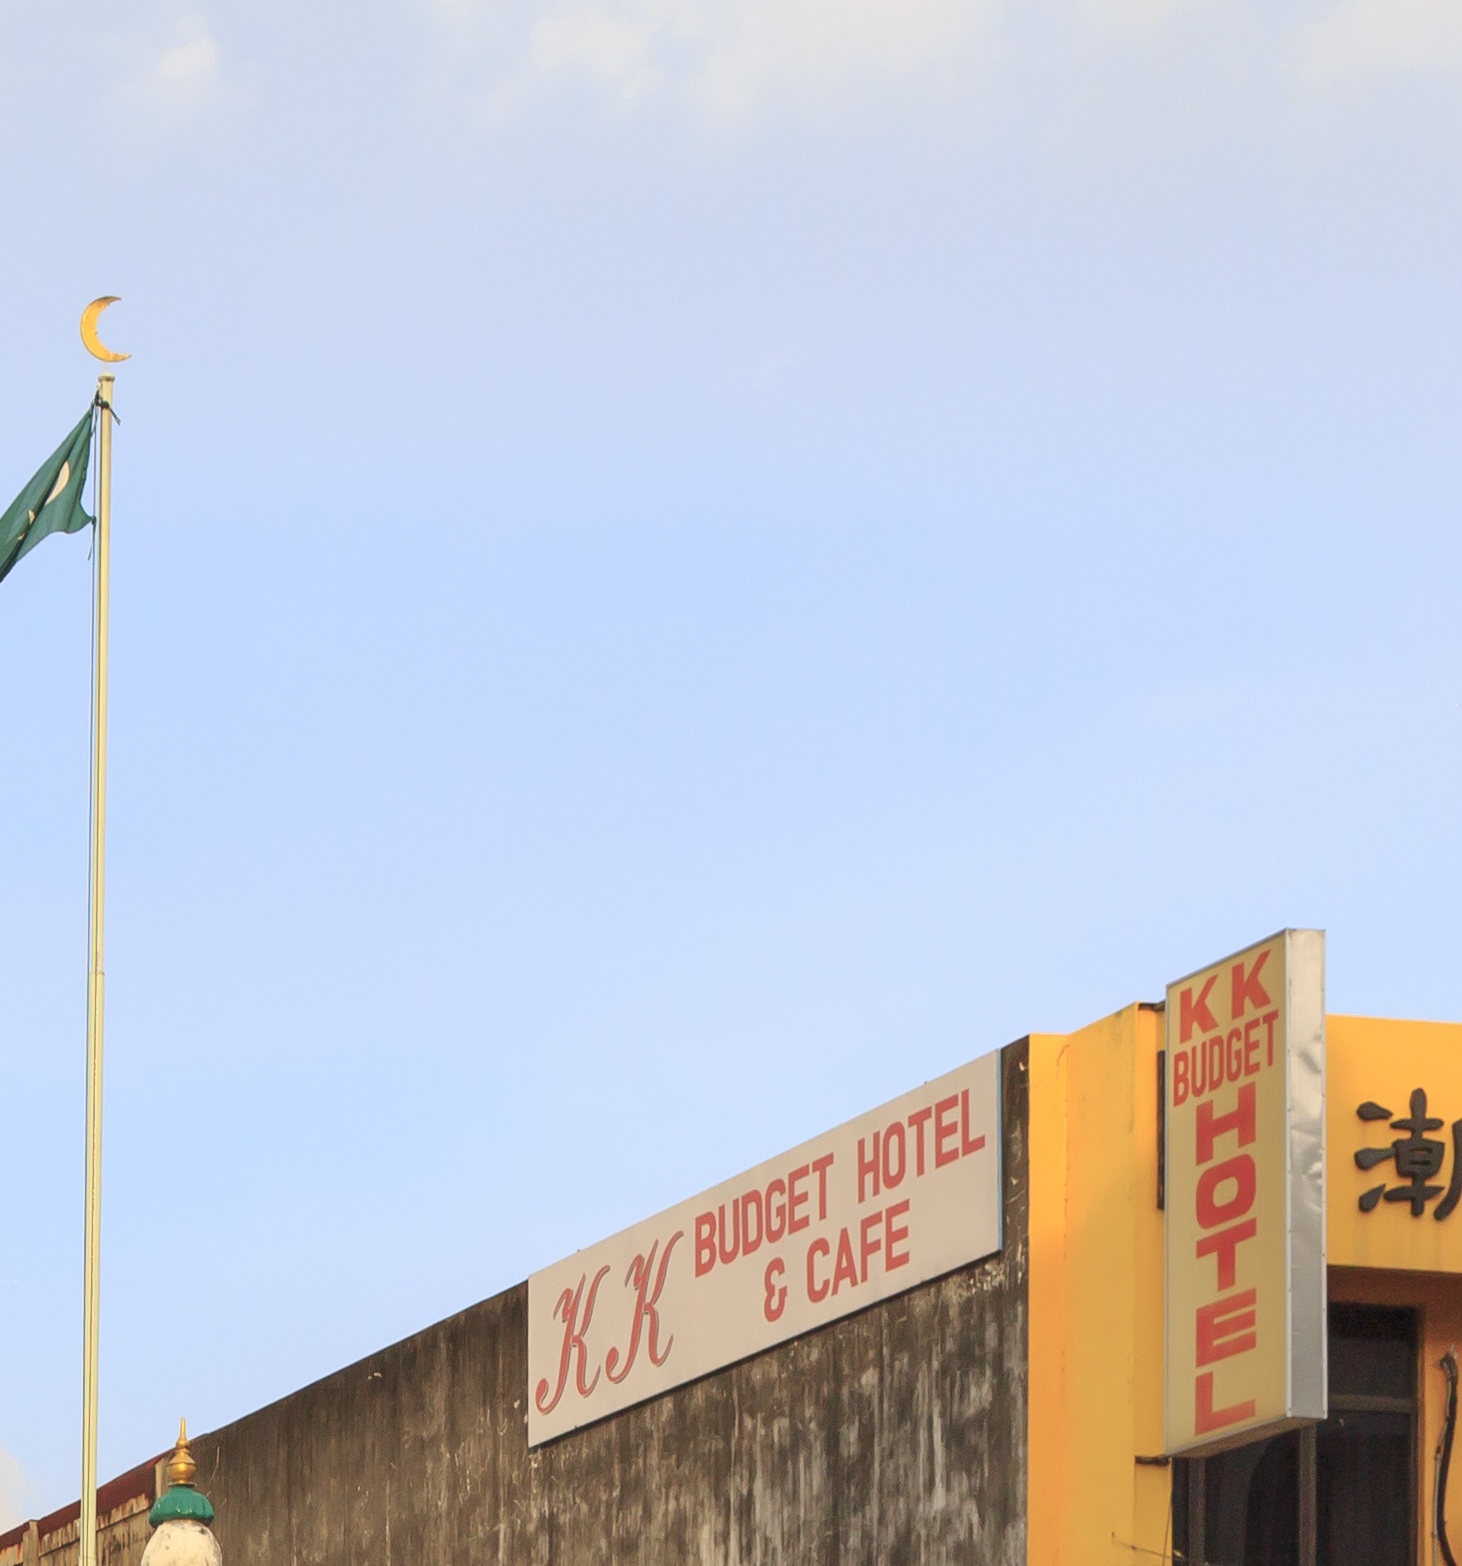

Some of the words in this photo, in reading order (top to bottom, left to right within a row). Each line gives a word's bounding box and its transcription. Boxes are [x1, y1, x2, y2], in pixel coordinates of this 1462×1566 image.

[1173, 1009, 1279, 1107] BUDGET
[694, 1152, 834, 1278] BUDGET
[857, 1089, 986, 1203] HOTEL
[764, 1258, 787, 1322] &
[806, 1200, 910, 1304] CAFE
[1195, 1081, 1257, 1436] HOTEL
